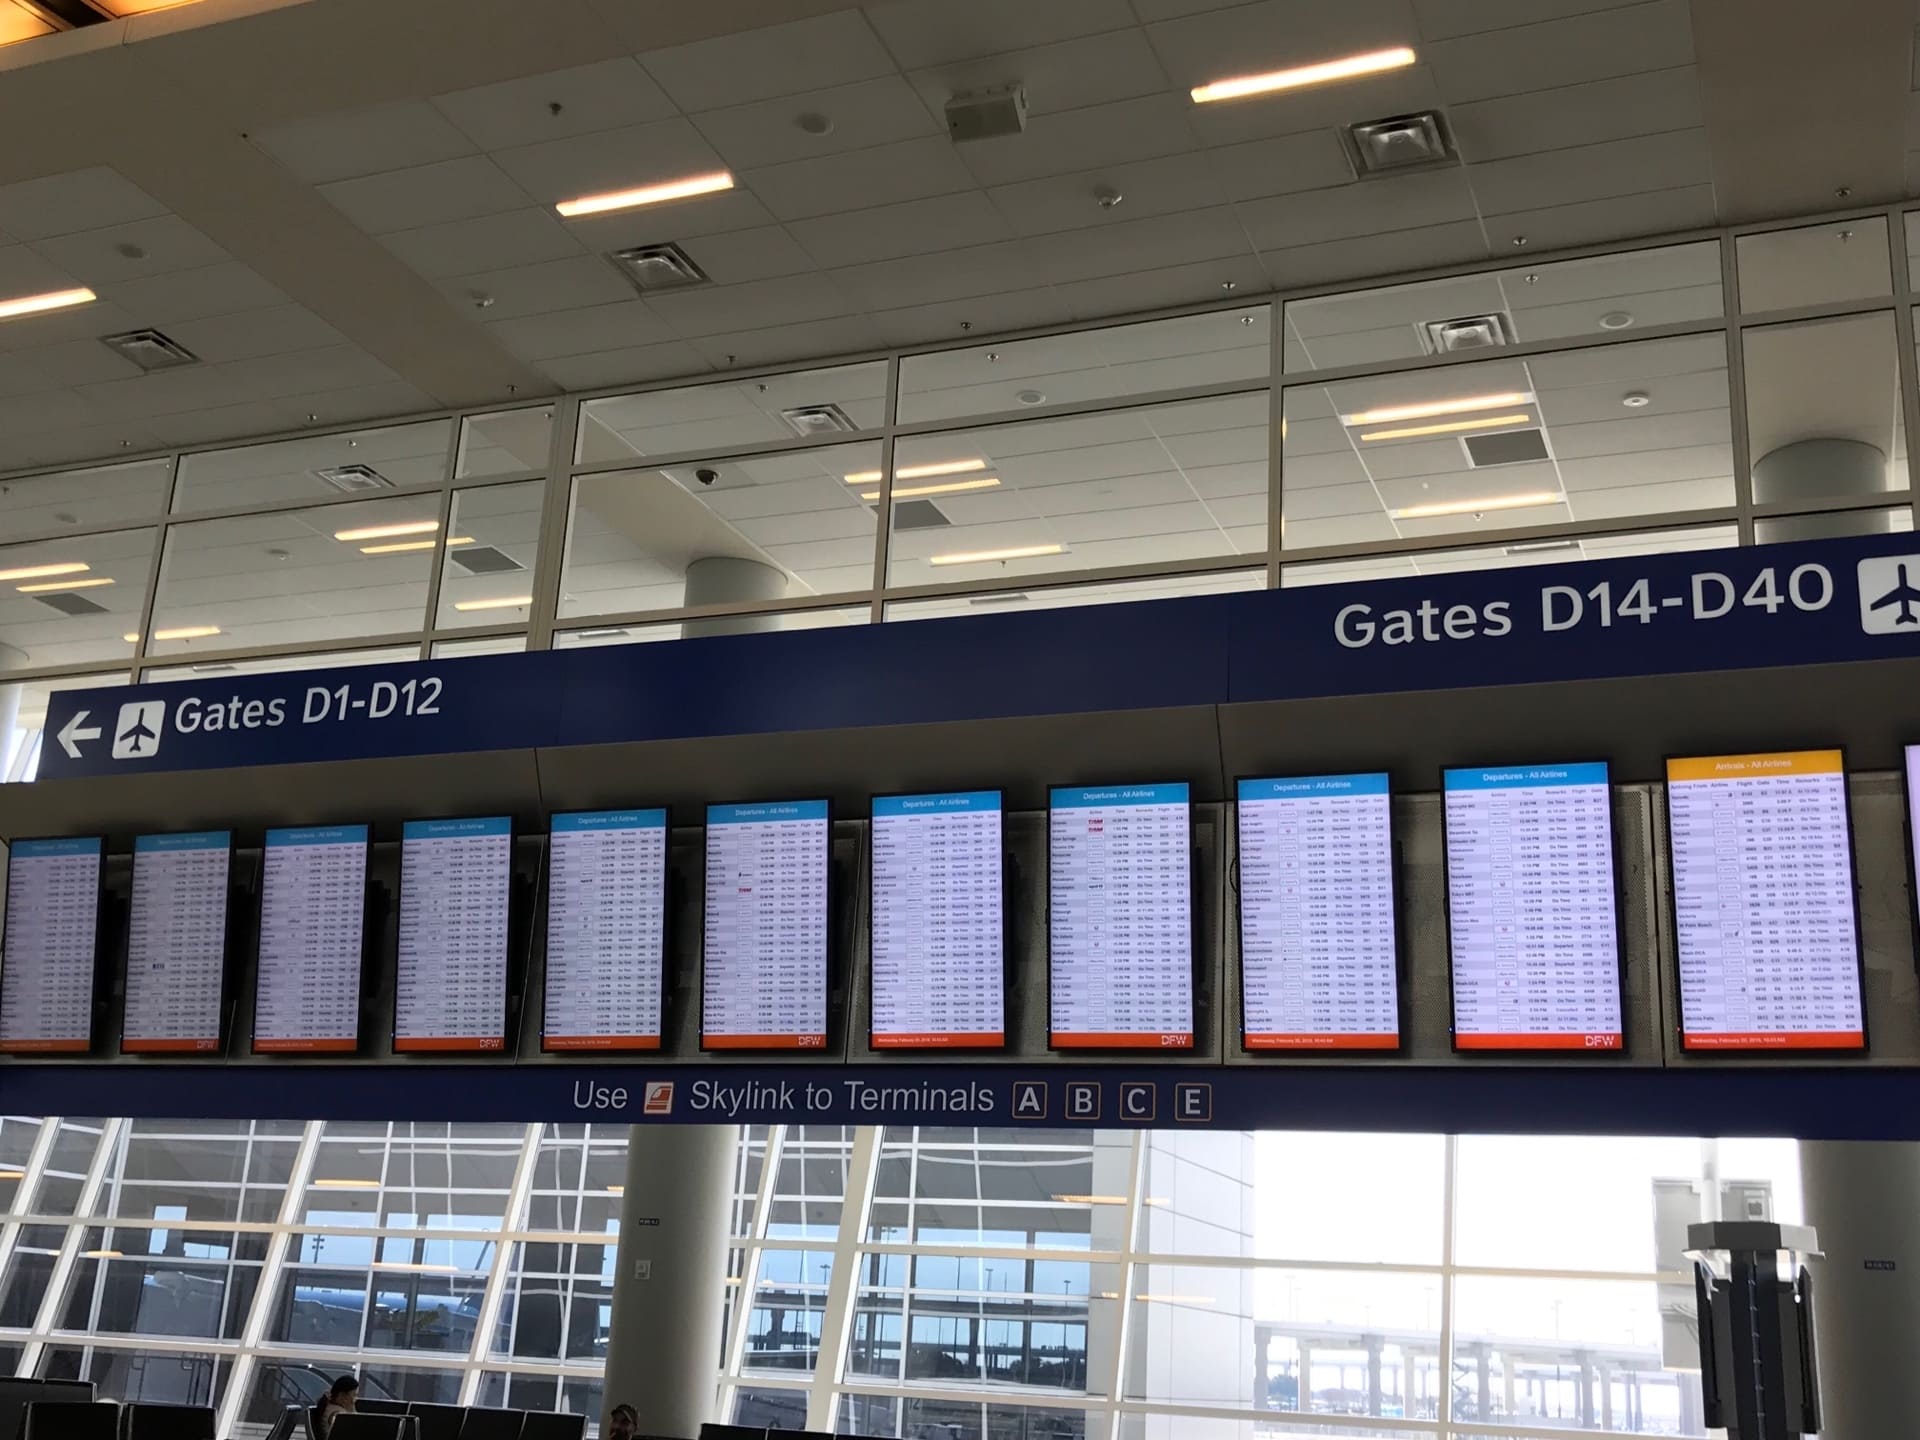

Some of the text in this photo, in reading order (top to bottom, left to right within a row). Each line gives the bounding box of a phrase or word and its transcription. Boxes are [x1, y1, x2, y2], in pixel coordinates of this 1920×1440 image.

[1334, 563, 1834, 648] Gates D14-D40
[175, 677, 443, 733] Gates D1-D12
[1715, 761, 1745, 771] Arrivals
[1751, 760, 1762, 769] All
[1763, 759, 1792, 768] Airlines
[1483, 773, 1523, 782] Departures
[1529, 771, 1540, 779] All
[1541, 770, 1568, 778] Airlines
[1273, 783, 1311, 792] Departures
[1083, 792, 1117, 801] Departures
[479, 1038, 500, 1049] DFW
[798, 1035, 821, 1047] DFW
[1161, 1035, 1187, 1046] DFW
[1585, 1035, 1615, 1047] DFW
[574, 1080, 1201, 1117] Use Skylink to Terminals A B C E
